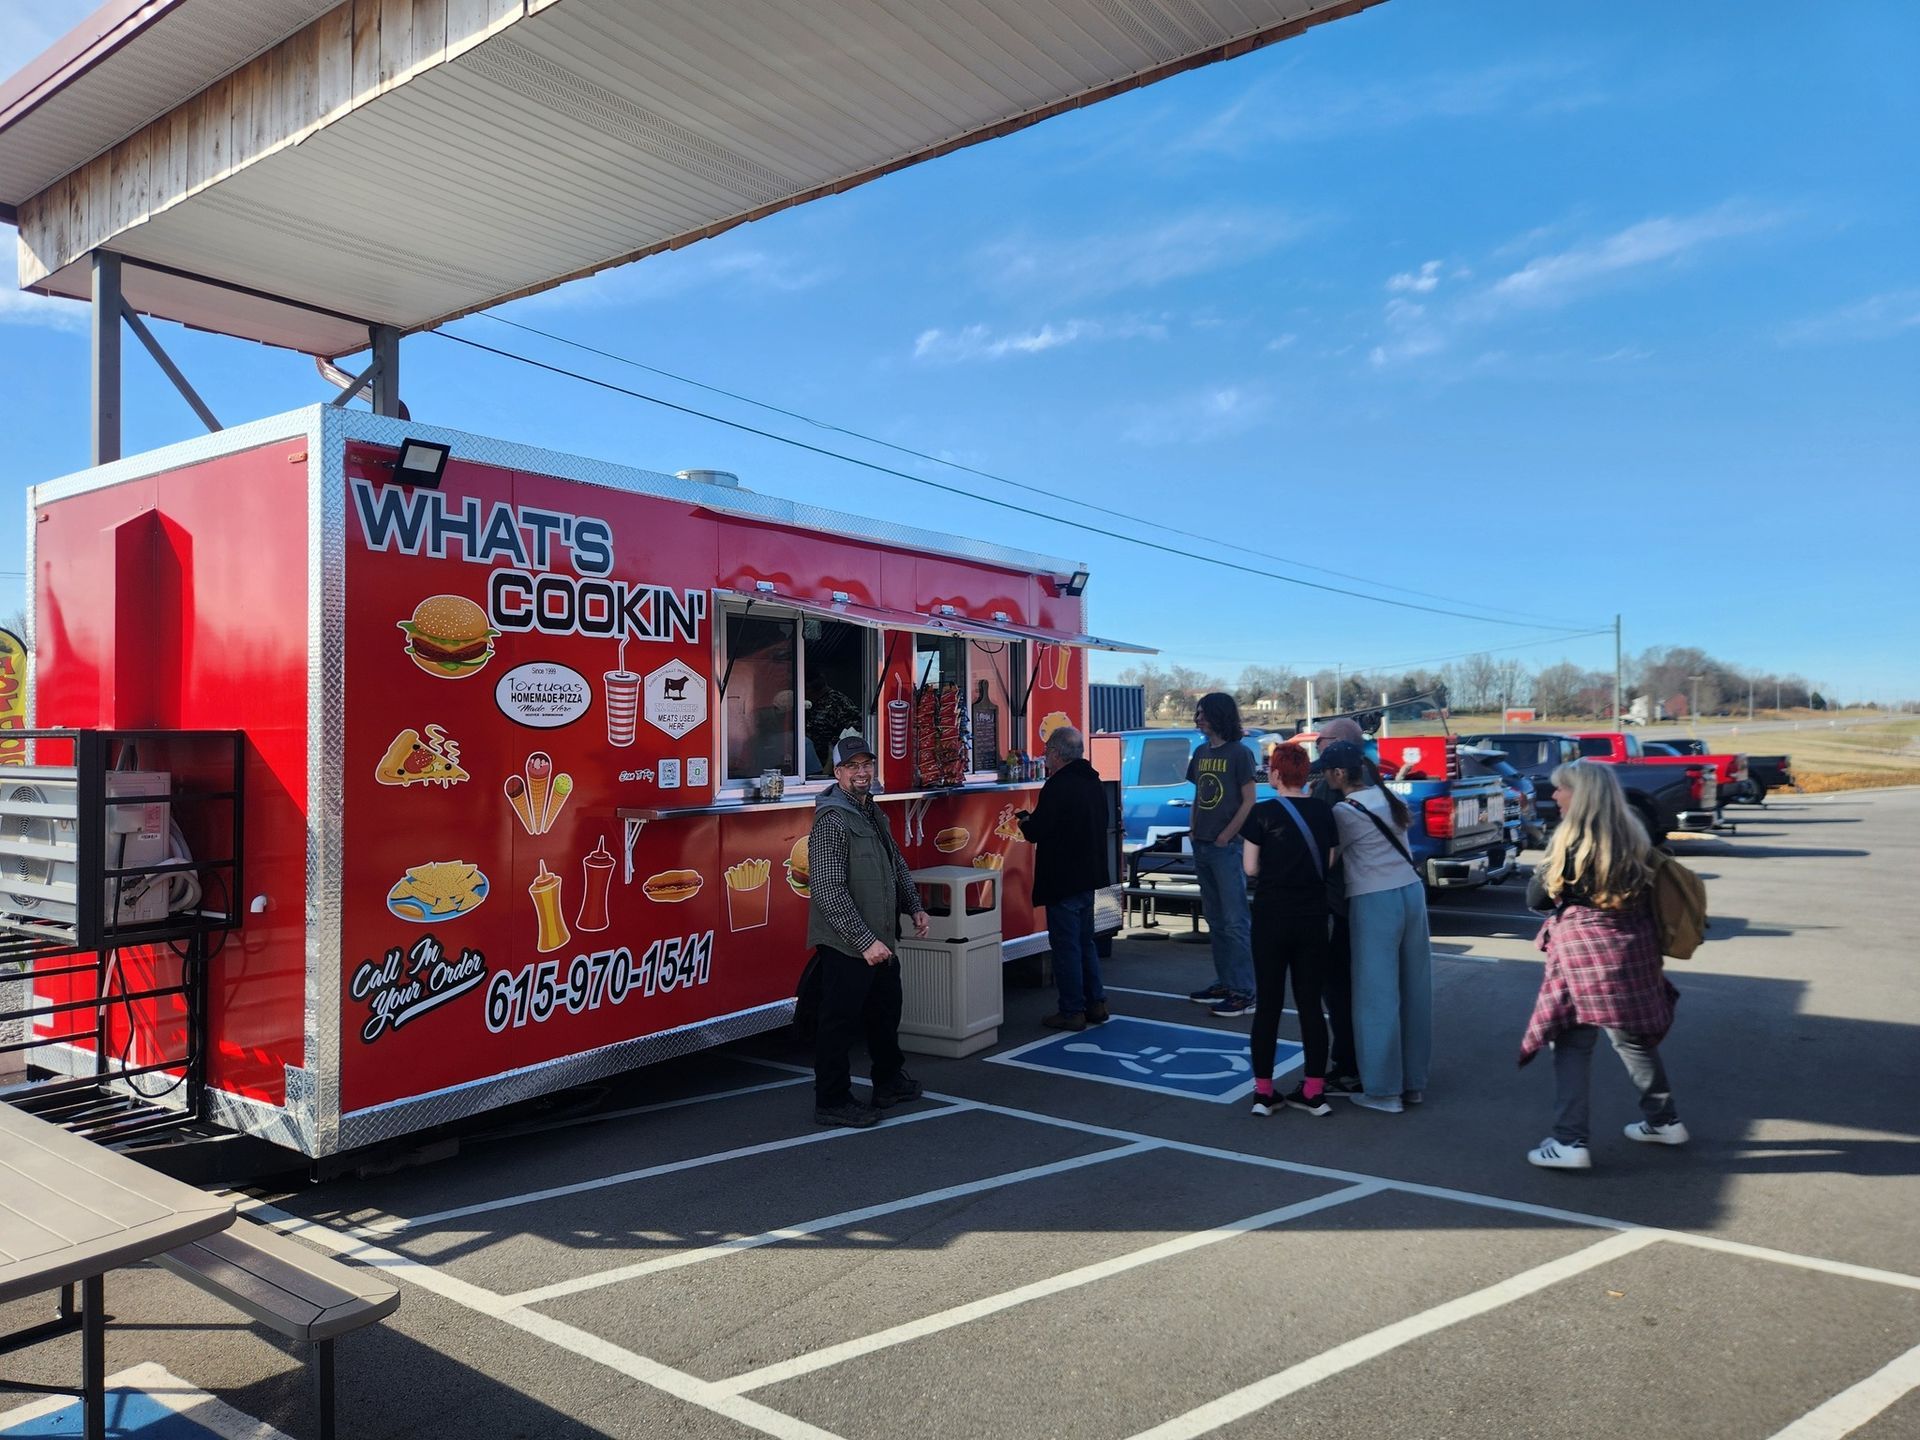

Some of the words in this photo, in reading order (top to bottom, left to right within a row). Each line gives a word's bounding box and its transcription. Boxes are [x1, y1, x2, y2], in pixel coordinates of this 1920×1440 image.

[350, 477, 613, 577] WHAT'S
[488, 568, 706, 643] COOKIN'
[507, 678, 583, 693] Tortugas
[658, 714, 678, 722] MEATS
[679, 714, 695, 722] USED
[668, 722, 685, 730] HERE
[352, 951, 400, 998] Call
[409, 937, 440, 974] In
[363, 981, 421, 1040] Your
[429, 952, 482, 991] Order
[485, 930, 714, 1033] 615-970-1541
